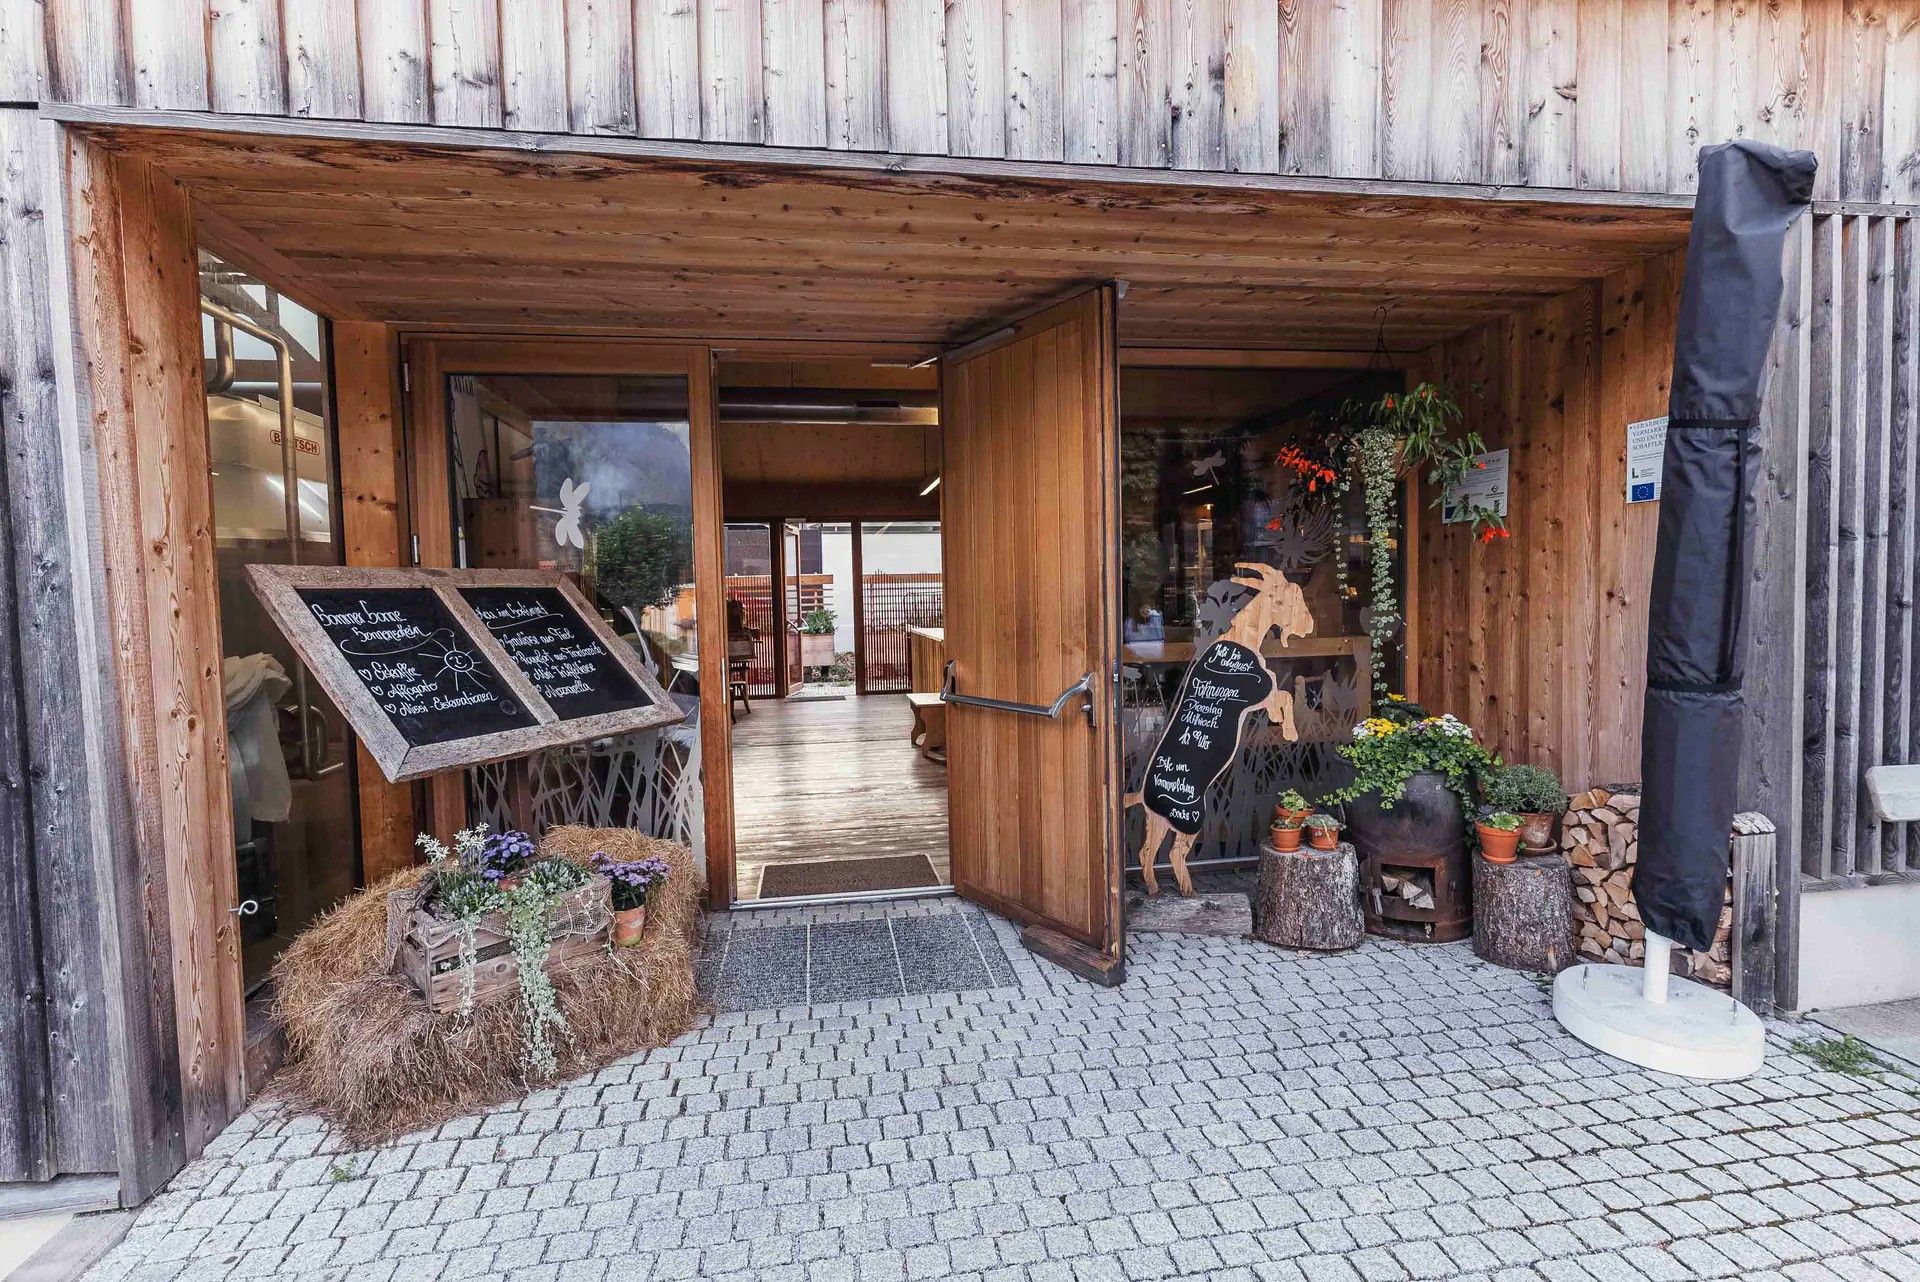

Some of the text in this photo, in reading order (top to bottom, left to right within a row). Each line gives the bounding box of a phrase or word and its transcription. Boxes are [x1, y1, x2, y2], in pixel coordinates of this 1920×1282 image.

[274, 432, 317, 453] BTSCH
[311, 600, 407, 626] Sommer Sonne
[351, 624, 432, 642] Sonnenschein
[540, 635, 555, 643] aus
[548, 627, 575, 641] Tirol
[553, 652, 568, 661] aus
[1208, 643, 1242, 663] Juli bis
[1220, 659, 1255, 673] August
[387, 679, 438, 701] Affogato
[544, 679, 595, 698] Mozzarella
[1190, 677, 1240, 702] Führungen
[1183, 698, 1223, 718] Dienstag
[1181, 710, 1220, 729] Mittwoch
[1197, 733, 1213, 750] Uhr
[1156, 756, 1191, 773] Bitte um
